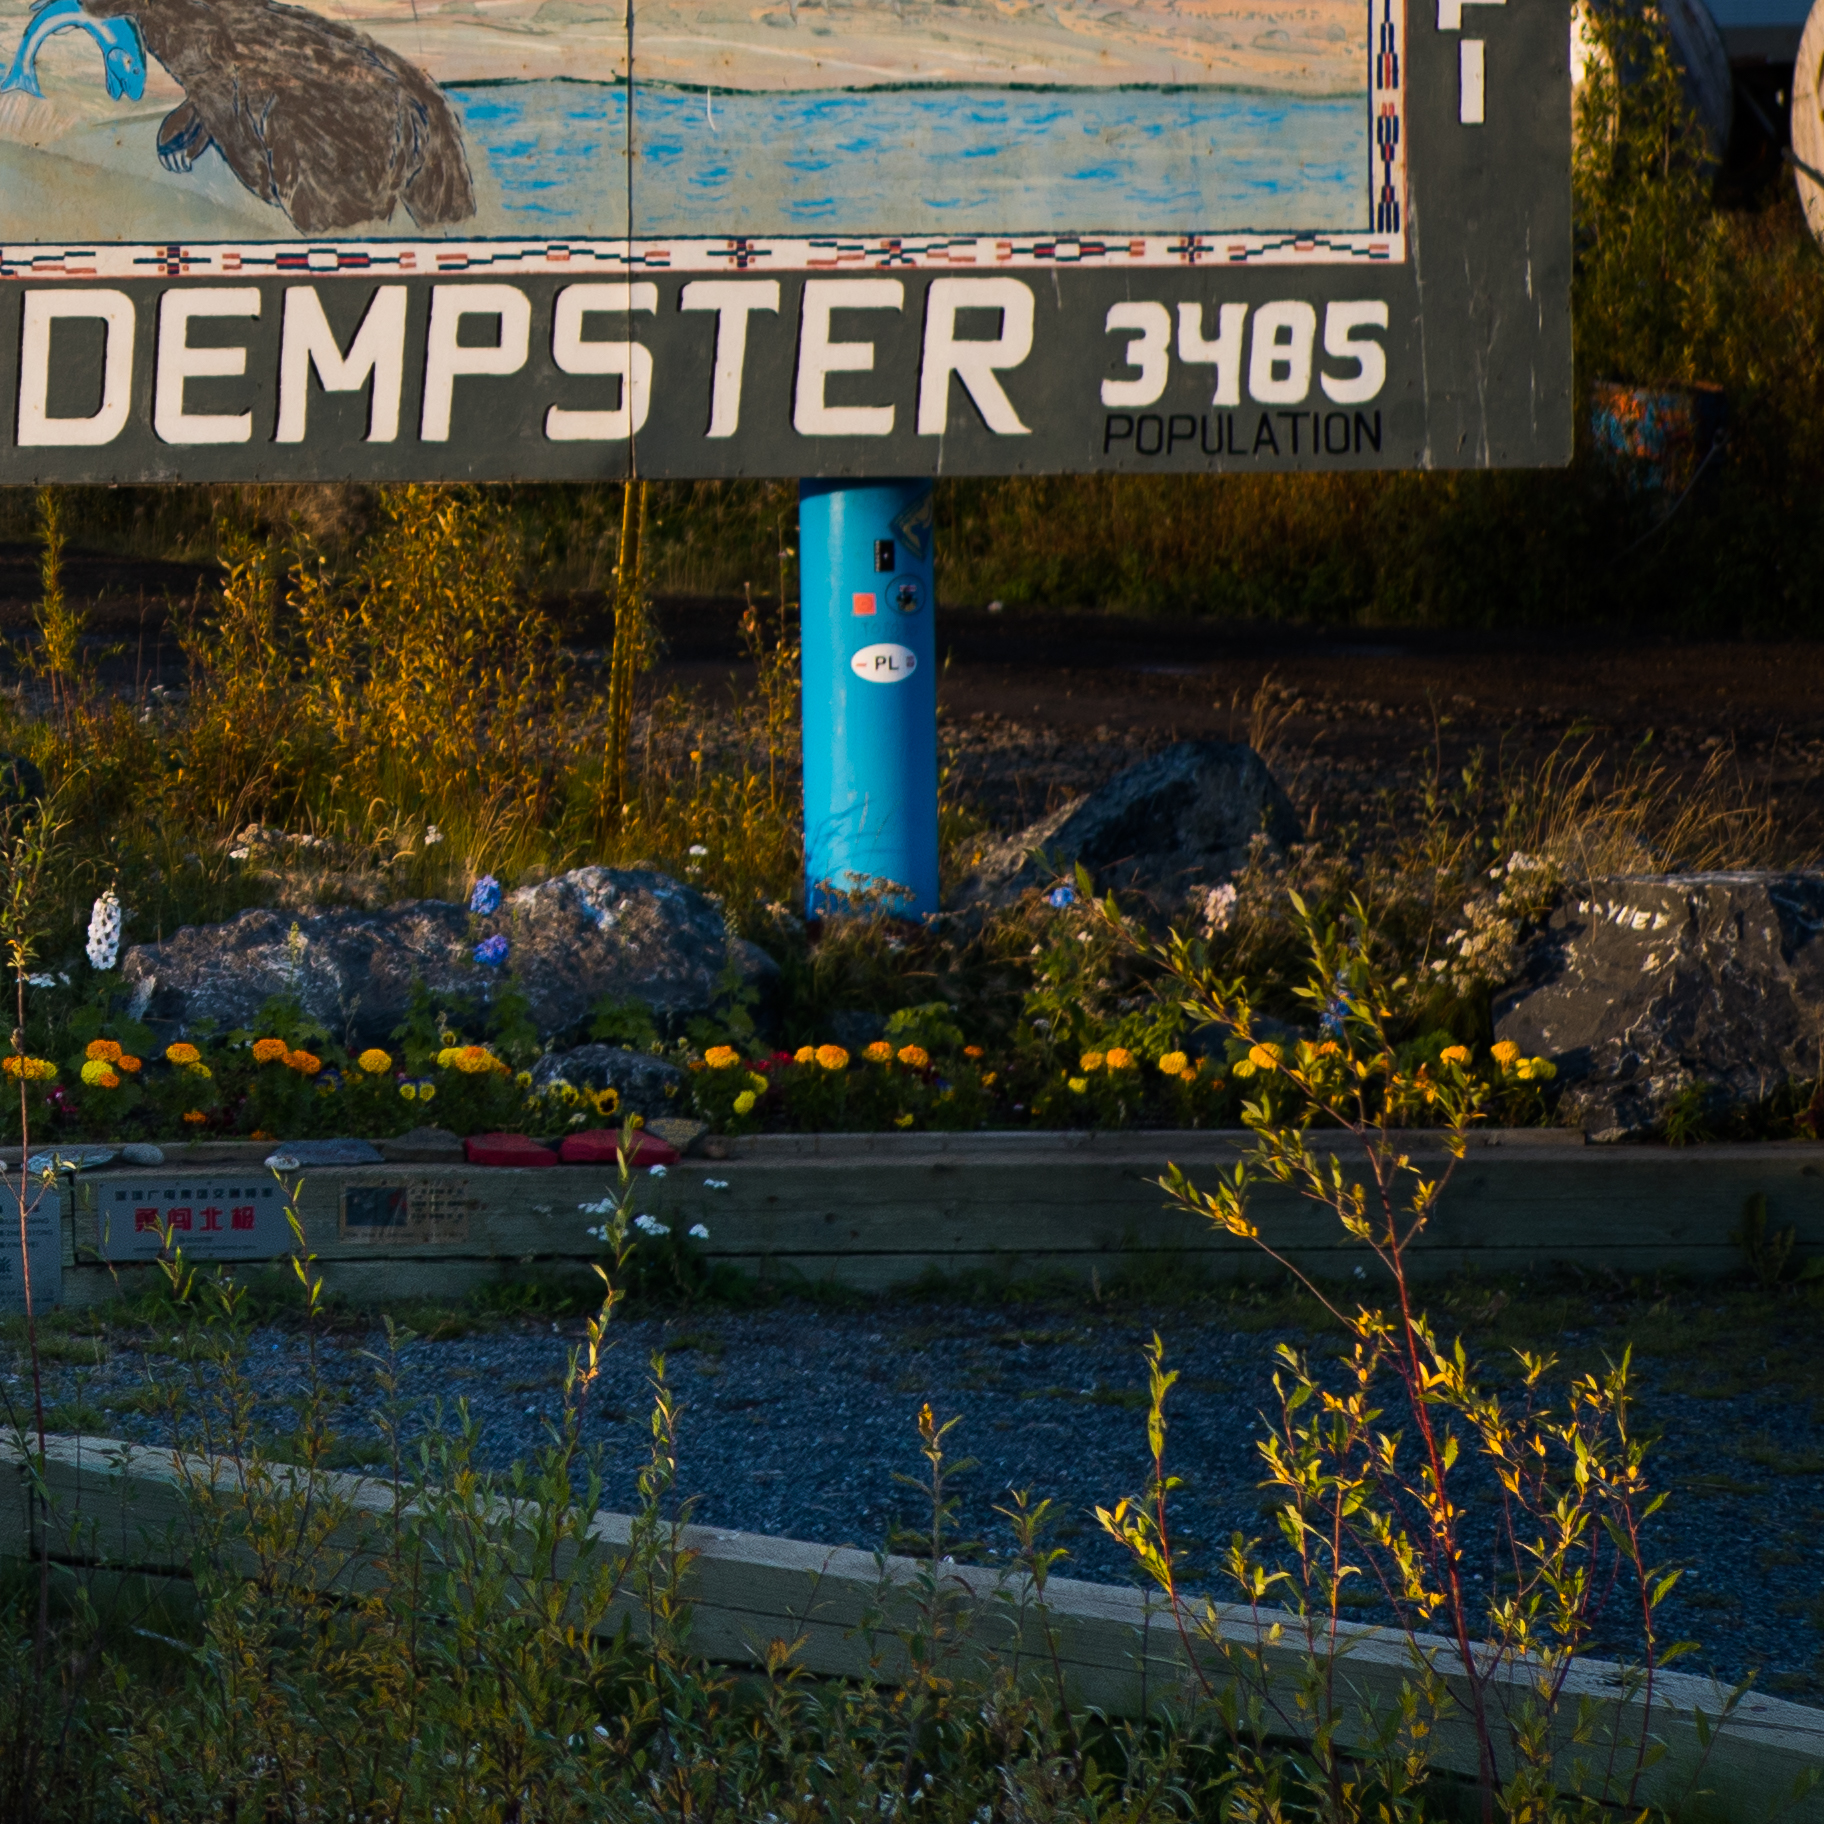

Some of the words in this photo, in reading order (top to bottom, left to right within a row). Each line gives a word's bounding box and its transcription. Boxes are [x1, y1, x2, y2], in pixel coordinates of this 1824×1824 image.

[1, 276, 1035, 446] DEMPSTER
[1100, 300, 1389, 408] 3485
[1103, 410, 1383, 458] POPULATION
[874, 655, 899, 670] PL
